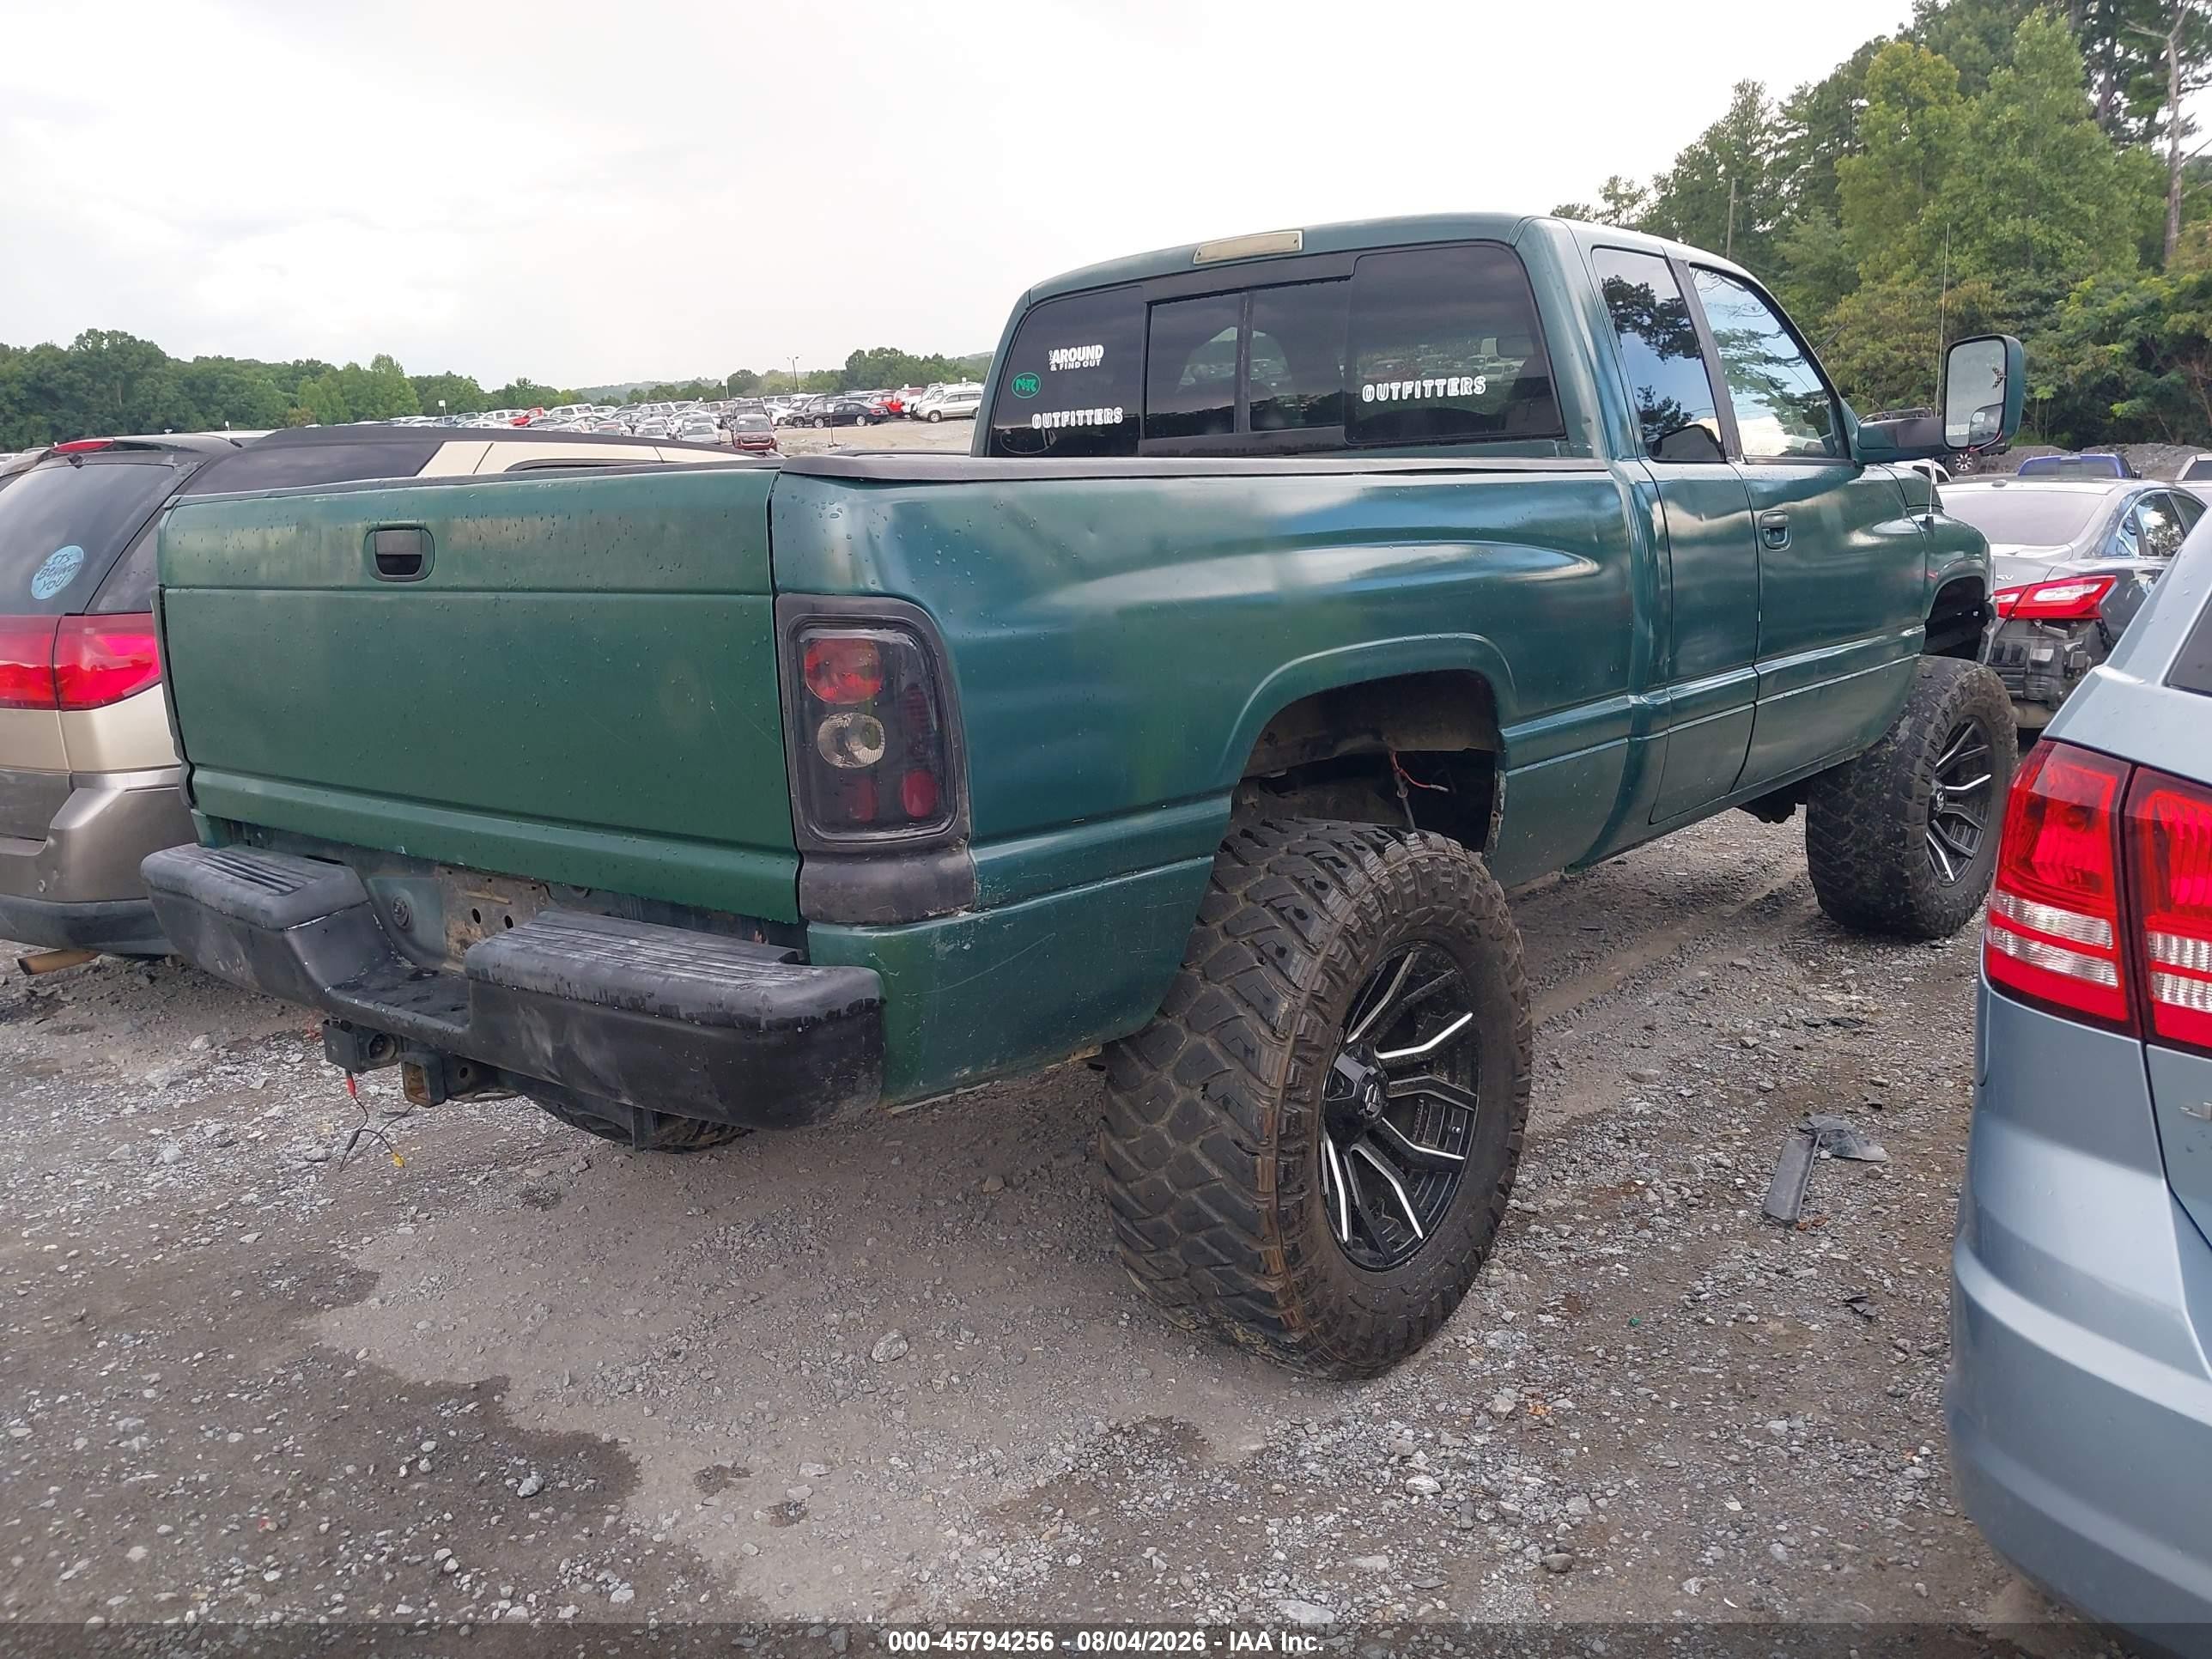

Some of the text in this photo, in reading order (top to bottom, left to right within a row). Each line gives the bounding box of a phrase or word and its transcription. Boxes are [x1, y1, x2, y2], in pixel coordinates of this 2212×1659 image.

[1052, 344, 1104, 364] AROUND
[1059, 361, 1081, 371] FIND
[1082, 358, 1101, 368] OUT
[1361, 375, 1486, 403] OUTFITTERS
[1031, 407, 1123, 429] OUTFITTERS
[39, 574, 68, 592] YOU
